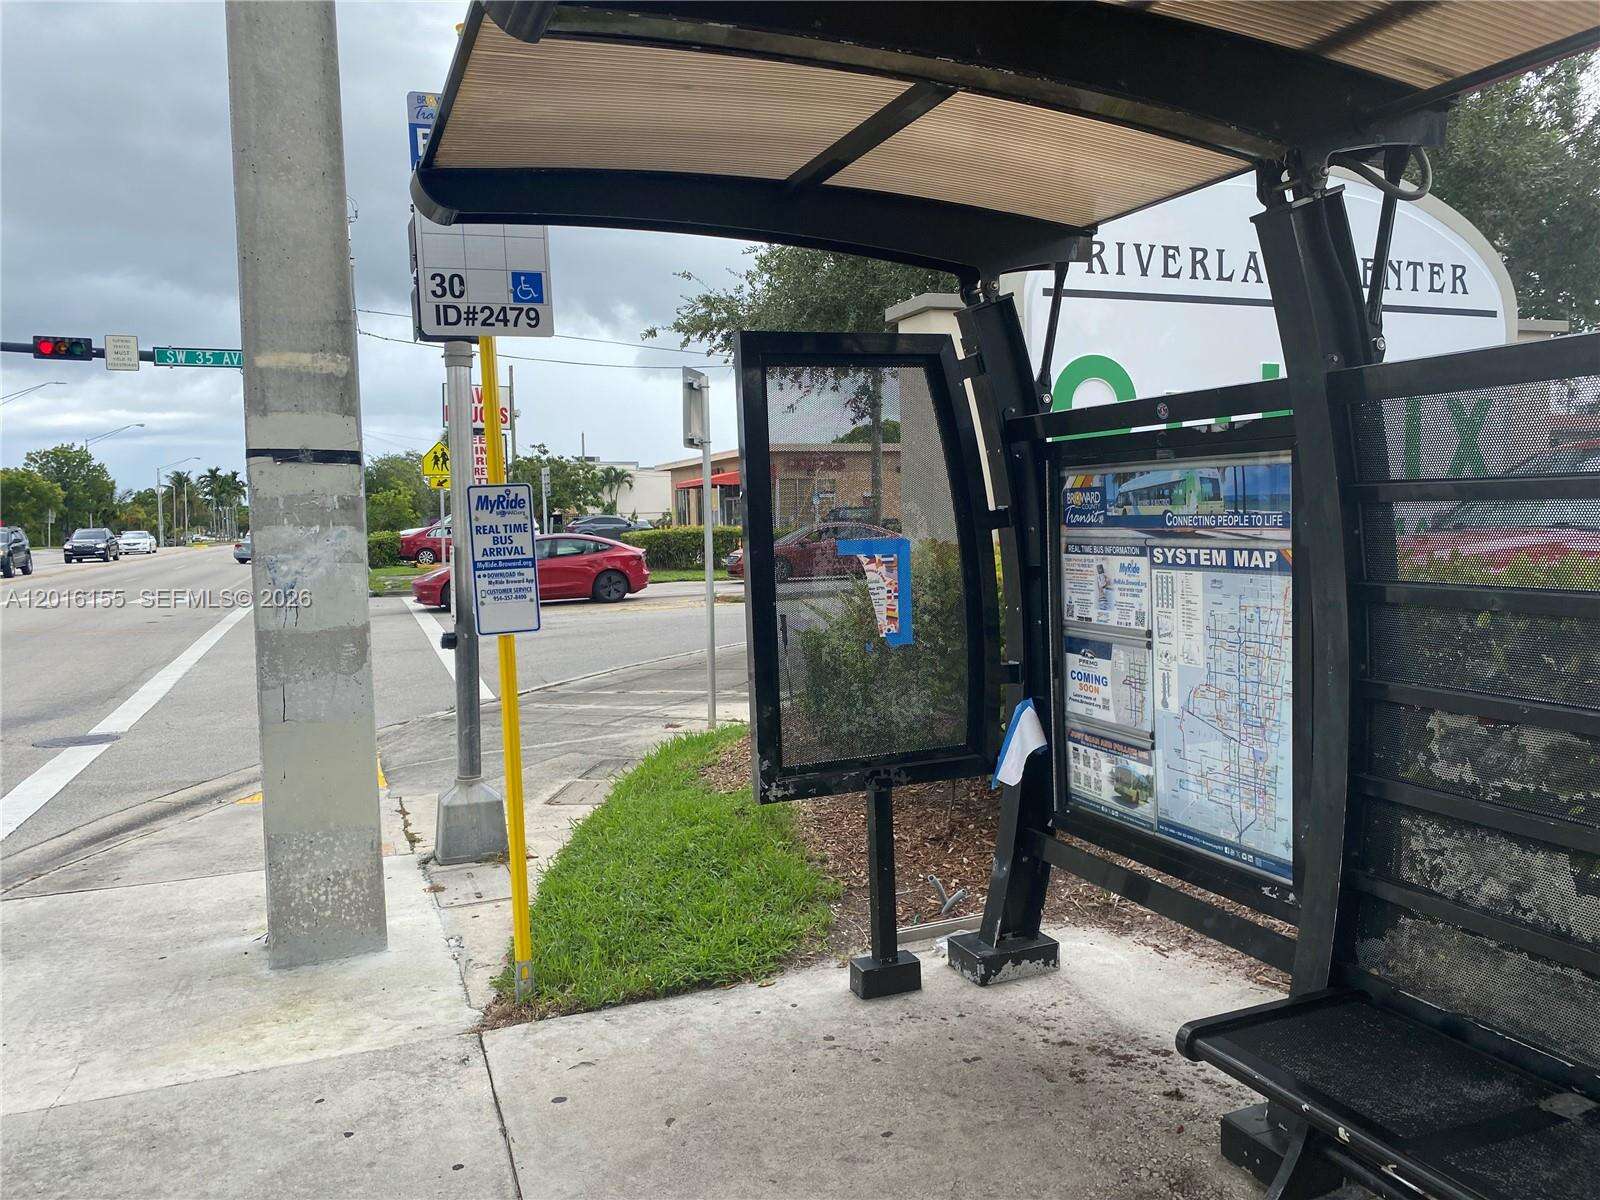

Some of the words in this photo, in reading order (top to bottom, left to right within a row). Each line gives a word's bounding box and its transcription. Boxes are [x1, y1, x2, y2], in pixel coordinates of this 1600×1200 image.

[1085, 240, 1264, 283] RIVERLA
[1361, 257, 1469, 295] ENTER
[430, 272, 466, 299] 30
[435, 304, 540, 328] ID#2479
[166, 350, 186, 364] SW
[195, 351, 214, 365] 35
[222, 352, 242, 365] AV
[475, 493, 526, 514] MyRide
[1065, 505, 1105, 524] Transit
[1217, 515, 1249, 526] PEOPLE
[1251, 515, 1262, 526] TO
[1264, 515, 1283, 526] LIFE
[475, 525, 501, 535] REAL
[502, 523, 528, 534] TIME
[492, 535, 514, 545] BUS
[481, 546, 526, 557] ARRIVAL
[1068, 544, 1081, 553] REAL
[1081, 545, 1093, 553] TIME
[1093, 546, 1104, 554] BUS
[1104, 546, 1140, 555] INFORMATION
[1153, 547, 1226, 566] SYSTEM
[1233, 549, 1277, 568] MAP
[487, 571, 516, 579] DOWNLOAD
[1070, 670, 1108, 687] COMING
[1078, 683, 1100, 695] SOON
